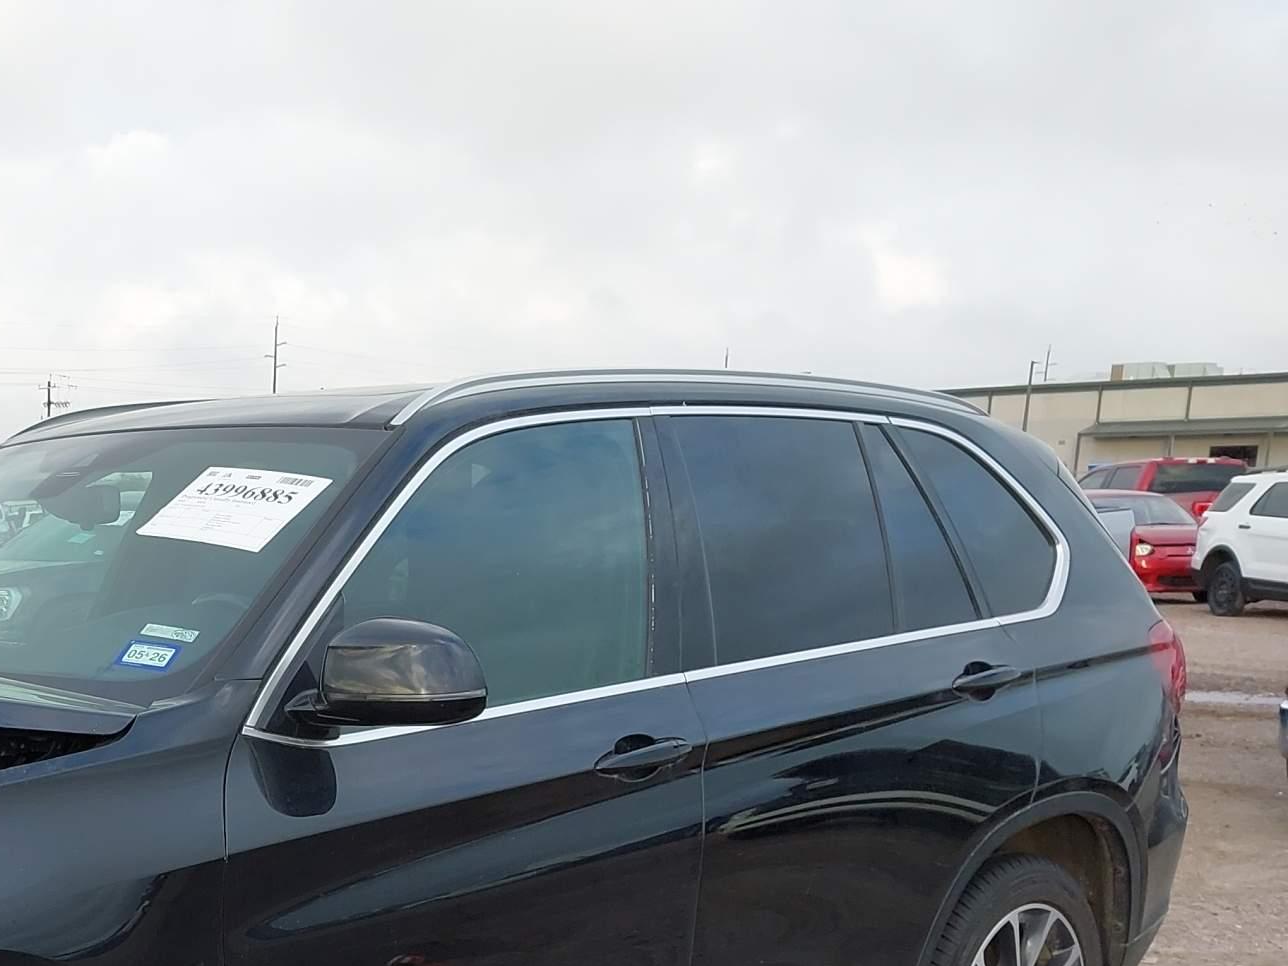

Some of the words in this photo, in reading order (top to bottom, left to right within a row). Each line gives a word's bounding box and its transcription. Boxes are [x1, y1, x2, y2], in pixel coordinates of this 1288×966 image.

[197, 482, 298, 505] 43996885
[127, 649, 145, 660] 05
[149, 651, 168, 663] 26
